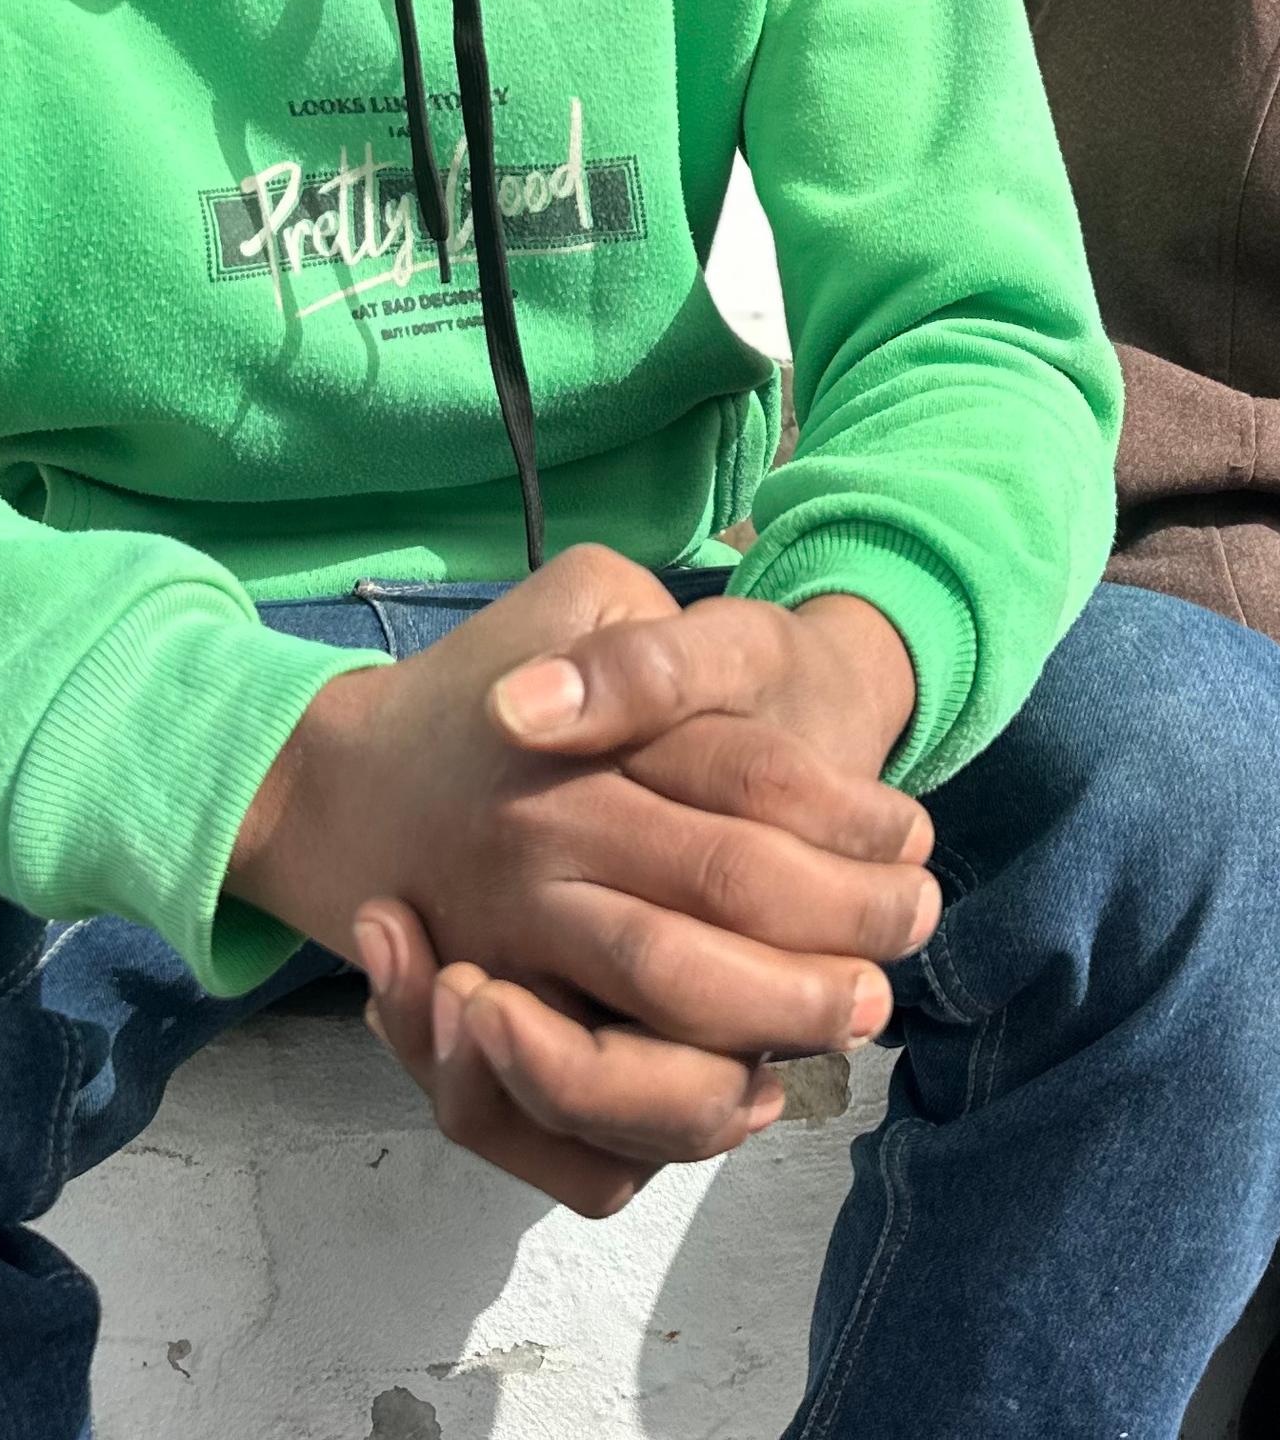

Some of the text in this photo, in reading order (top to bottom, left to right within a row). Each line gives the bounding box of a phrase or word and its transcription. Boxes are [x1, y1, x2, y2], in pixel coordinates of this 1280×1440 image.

[288, 97, 366, 117] LOOKS
[428, 86, 509, 111] TOY
[239, 142, 417, 313] Pretty
[382, 296, 417, 317] BAD
[456, 315, 485, 330] CAR
